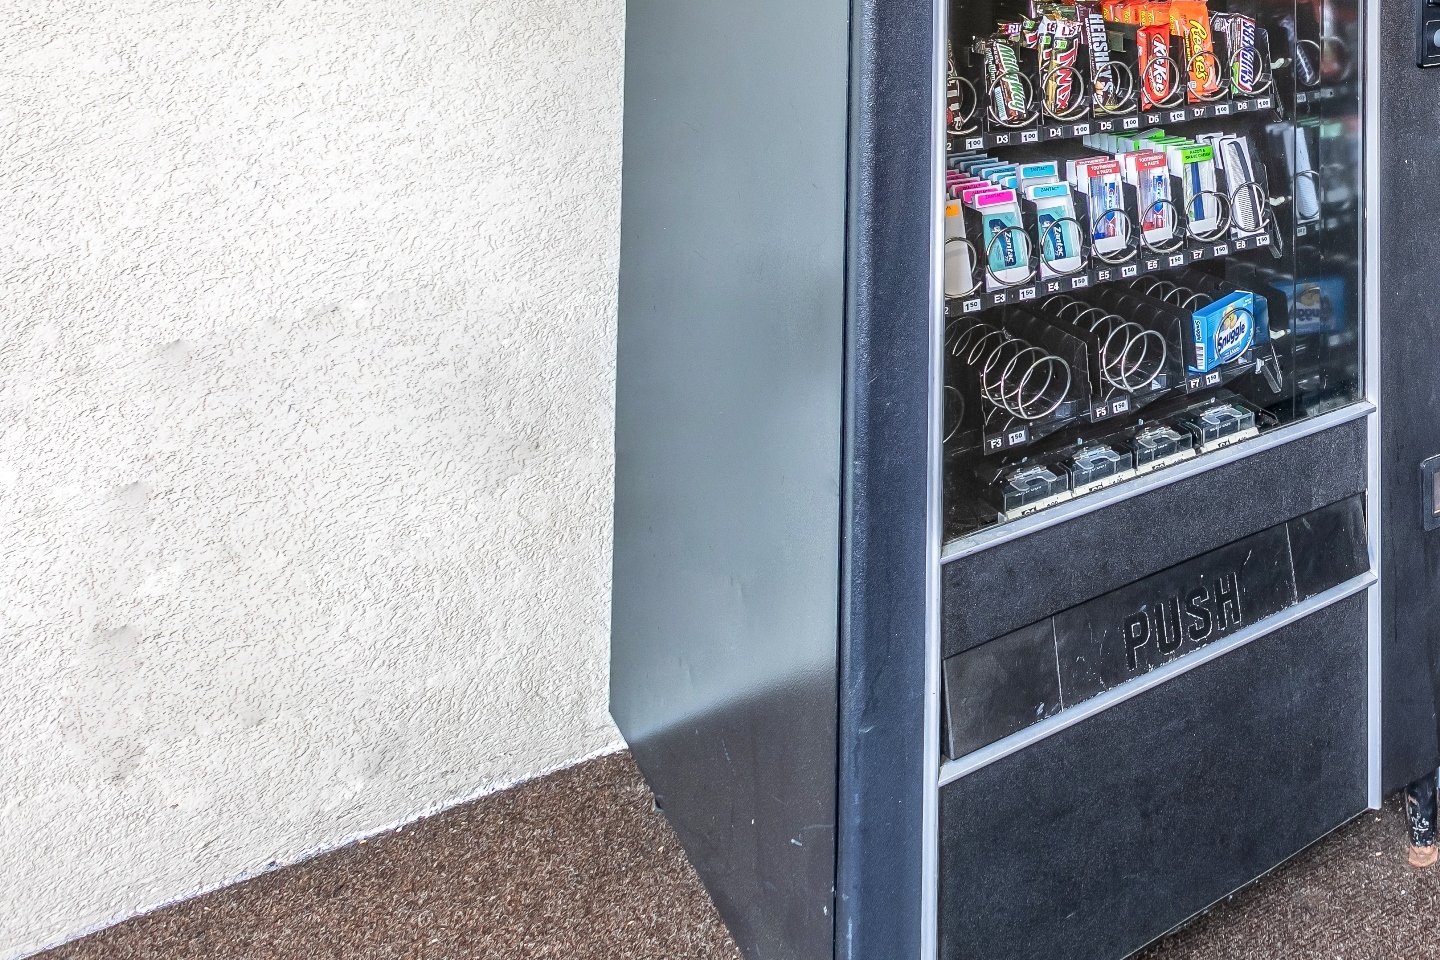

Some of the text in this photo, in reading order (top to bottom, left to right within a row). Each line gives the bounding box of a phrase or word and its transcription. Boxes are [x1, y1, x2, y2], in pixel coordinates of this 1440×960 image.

[1189, 20, 1208, 81] Reese's
[1241, 20, 1255, 84] SNICKERS
[1056, 38, 1078, 109] TWIX
[1237, 102, 1247, 110] D8
[1194, 108, 1205, 116] D7
[1148, 115, 1159, 123] D6
[1101, 121, 1112, 130] D5
[1050, 128, 1062, 136] D4
[997, 135, 1009, 144] D3
[947, 142, 952, 150] 2
[1054, 226, 1064, 258] Zantac
[1004, 231, 1014, 263] Zantac
[1193, 250, 1203, 258] E7
[1147, 261, 1158, 269] E6
[1099, 271, 1110, 280] E5
[1048, 283, 1059, 291] E4
[995, 294, 1006, 302] E3
[1217, 321, 1246, 352] Snuggle
[1190, 379, 1200, 388] F7
[1096, 407, 1107, 417] F5
[991, 439, 1002, 448] F3
[1123, 571, 1242, 671] PUSH
